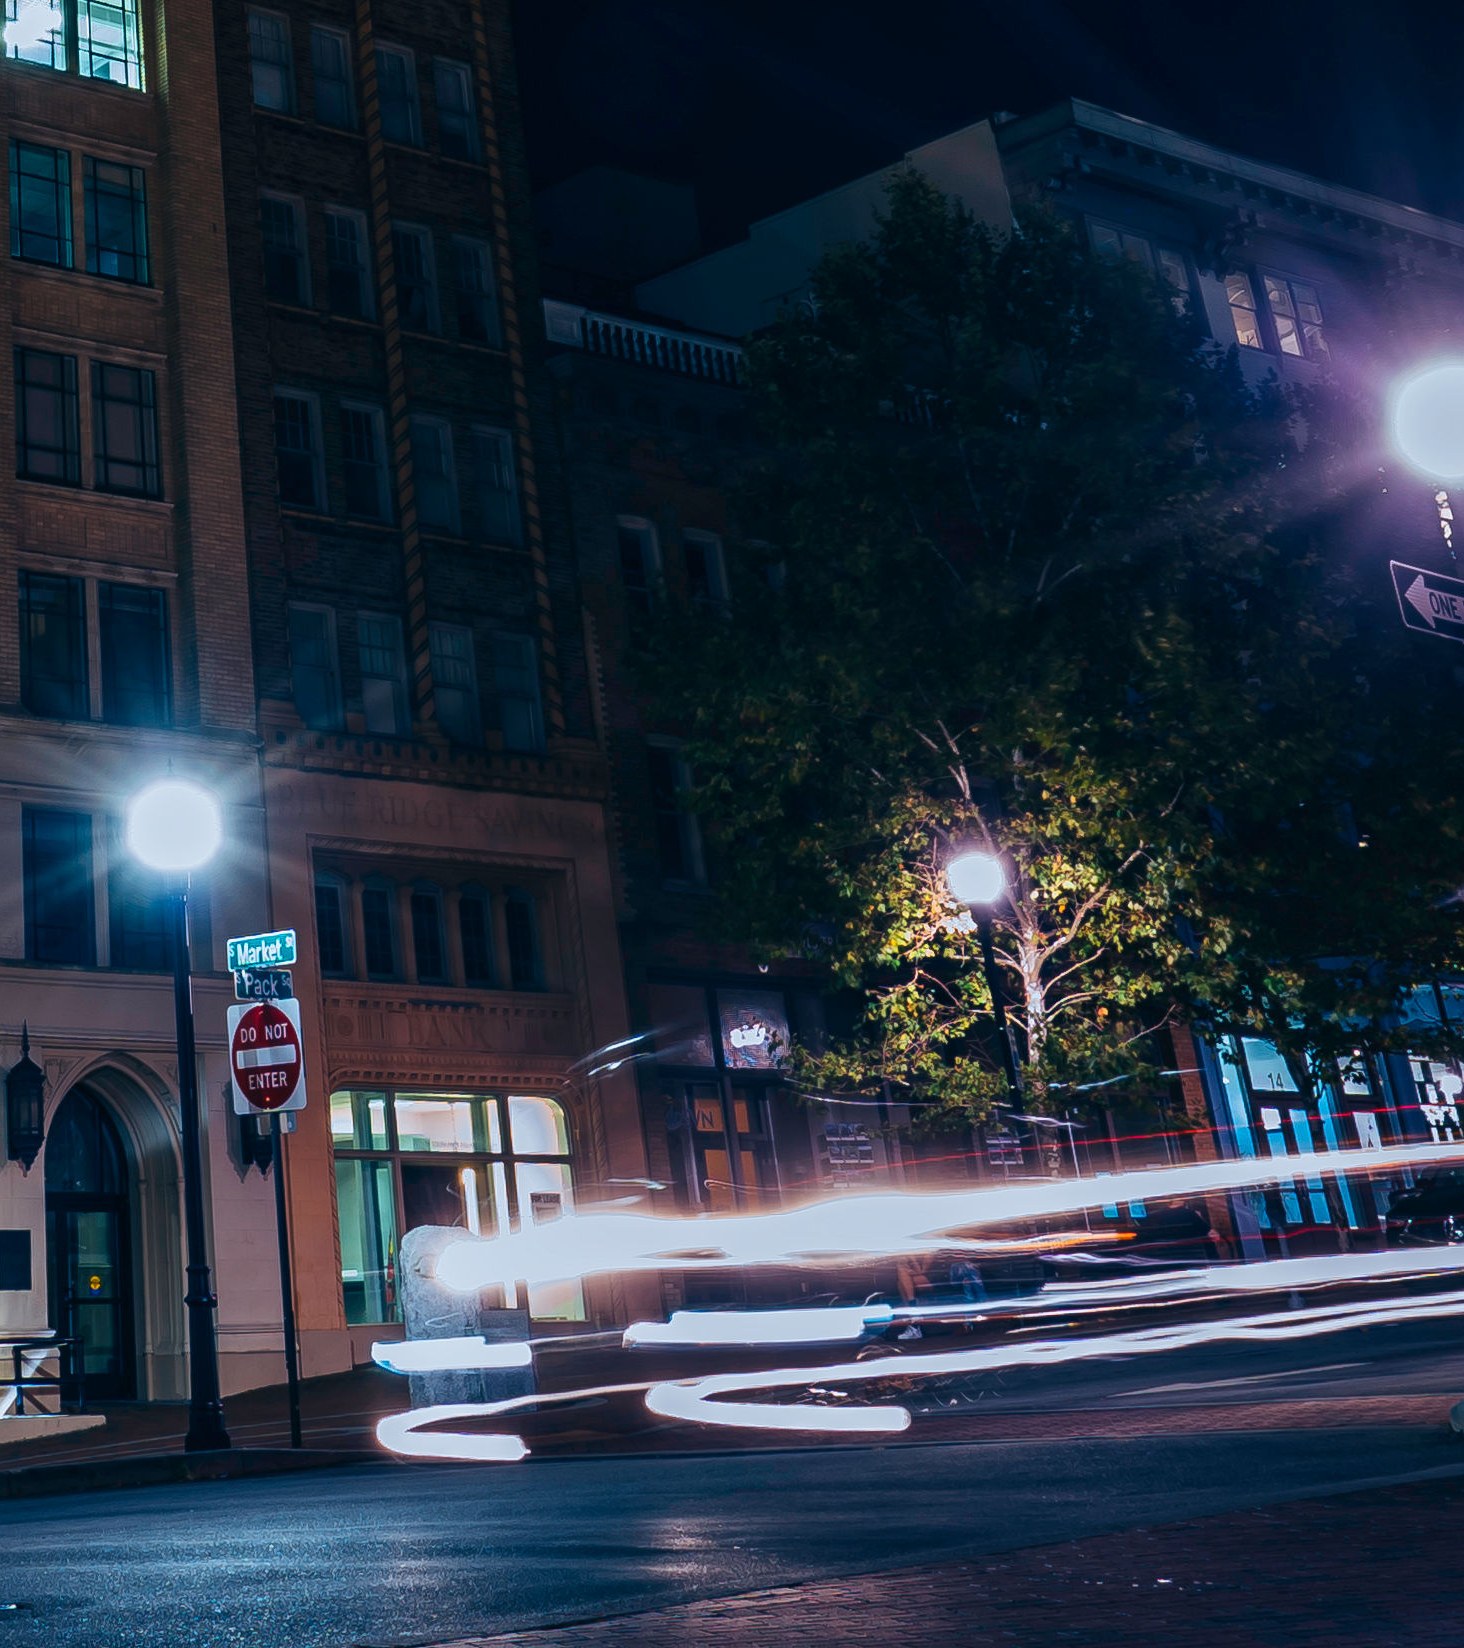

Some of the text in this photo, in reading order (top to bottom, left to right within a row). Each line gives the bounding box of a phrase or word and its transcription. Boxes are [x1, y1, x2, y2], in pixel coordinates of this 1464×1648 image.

[1428, 592, 1463, 620] ONE
[368, 792, 466, 832] RIDGE
[236, 939, 282, 965] Market
[244, 972, 279, 996] Pack
[281, 974, 291, 988] Sq
[240, 1023, 288, 1043] DO NOT
[407, 1013, 492, 1049] BANK
[249, 1071, 288, 1090] ENTER
[1268, 1072, 1284, 1089] 14
